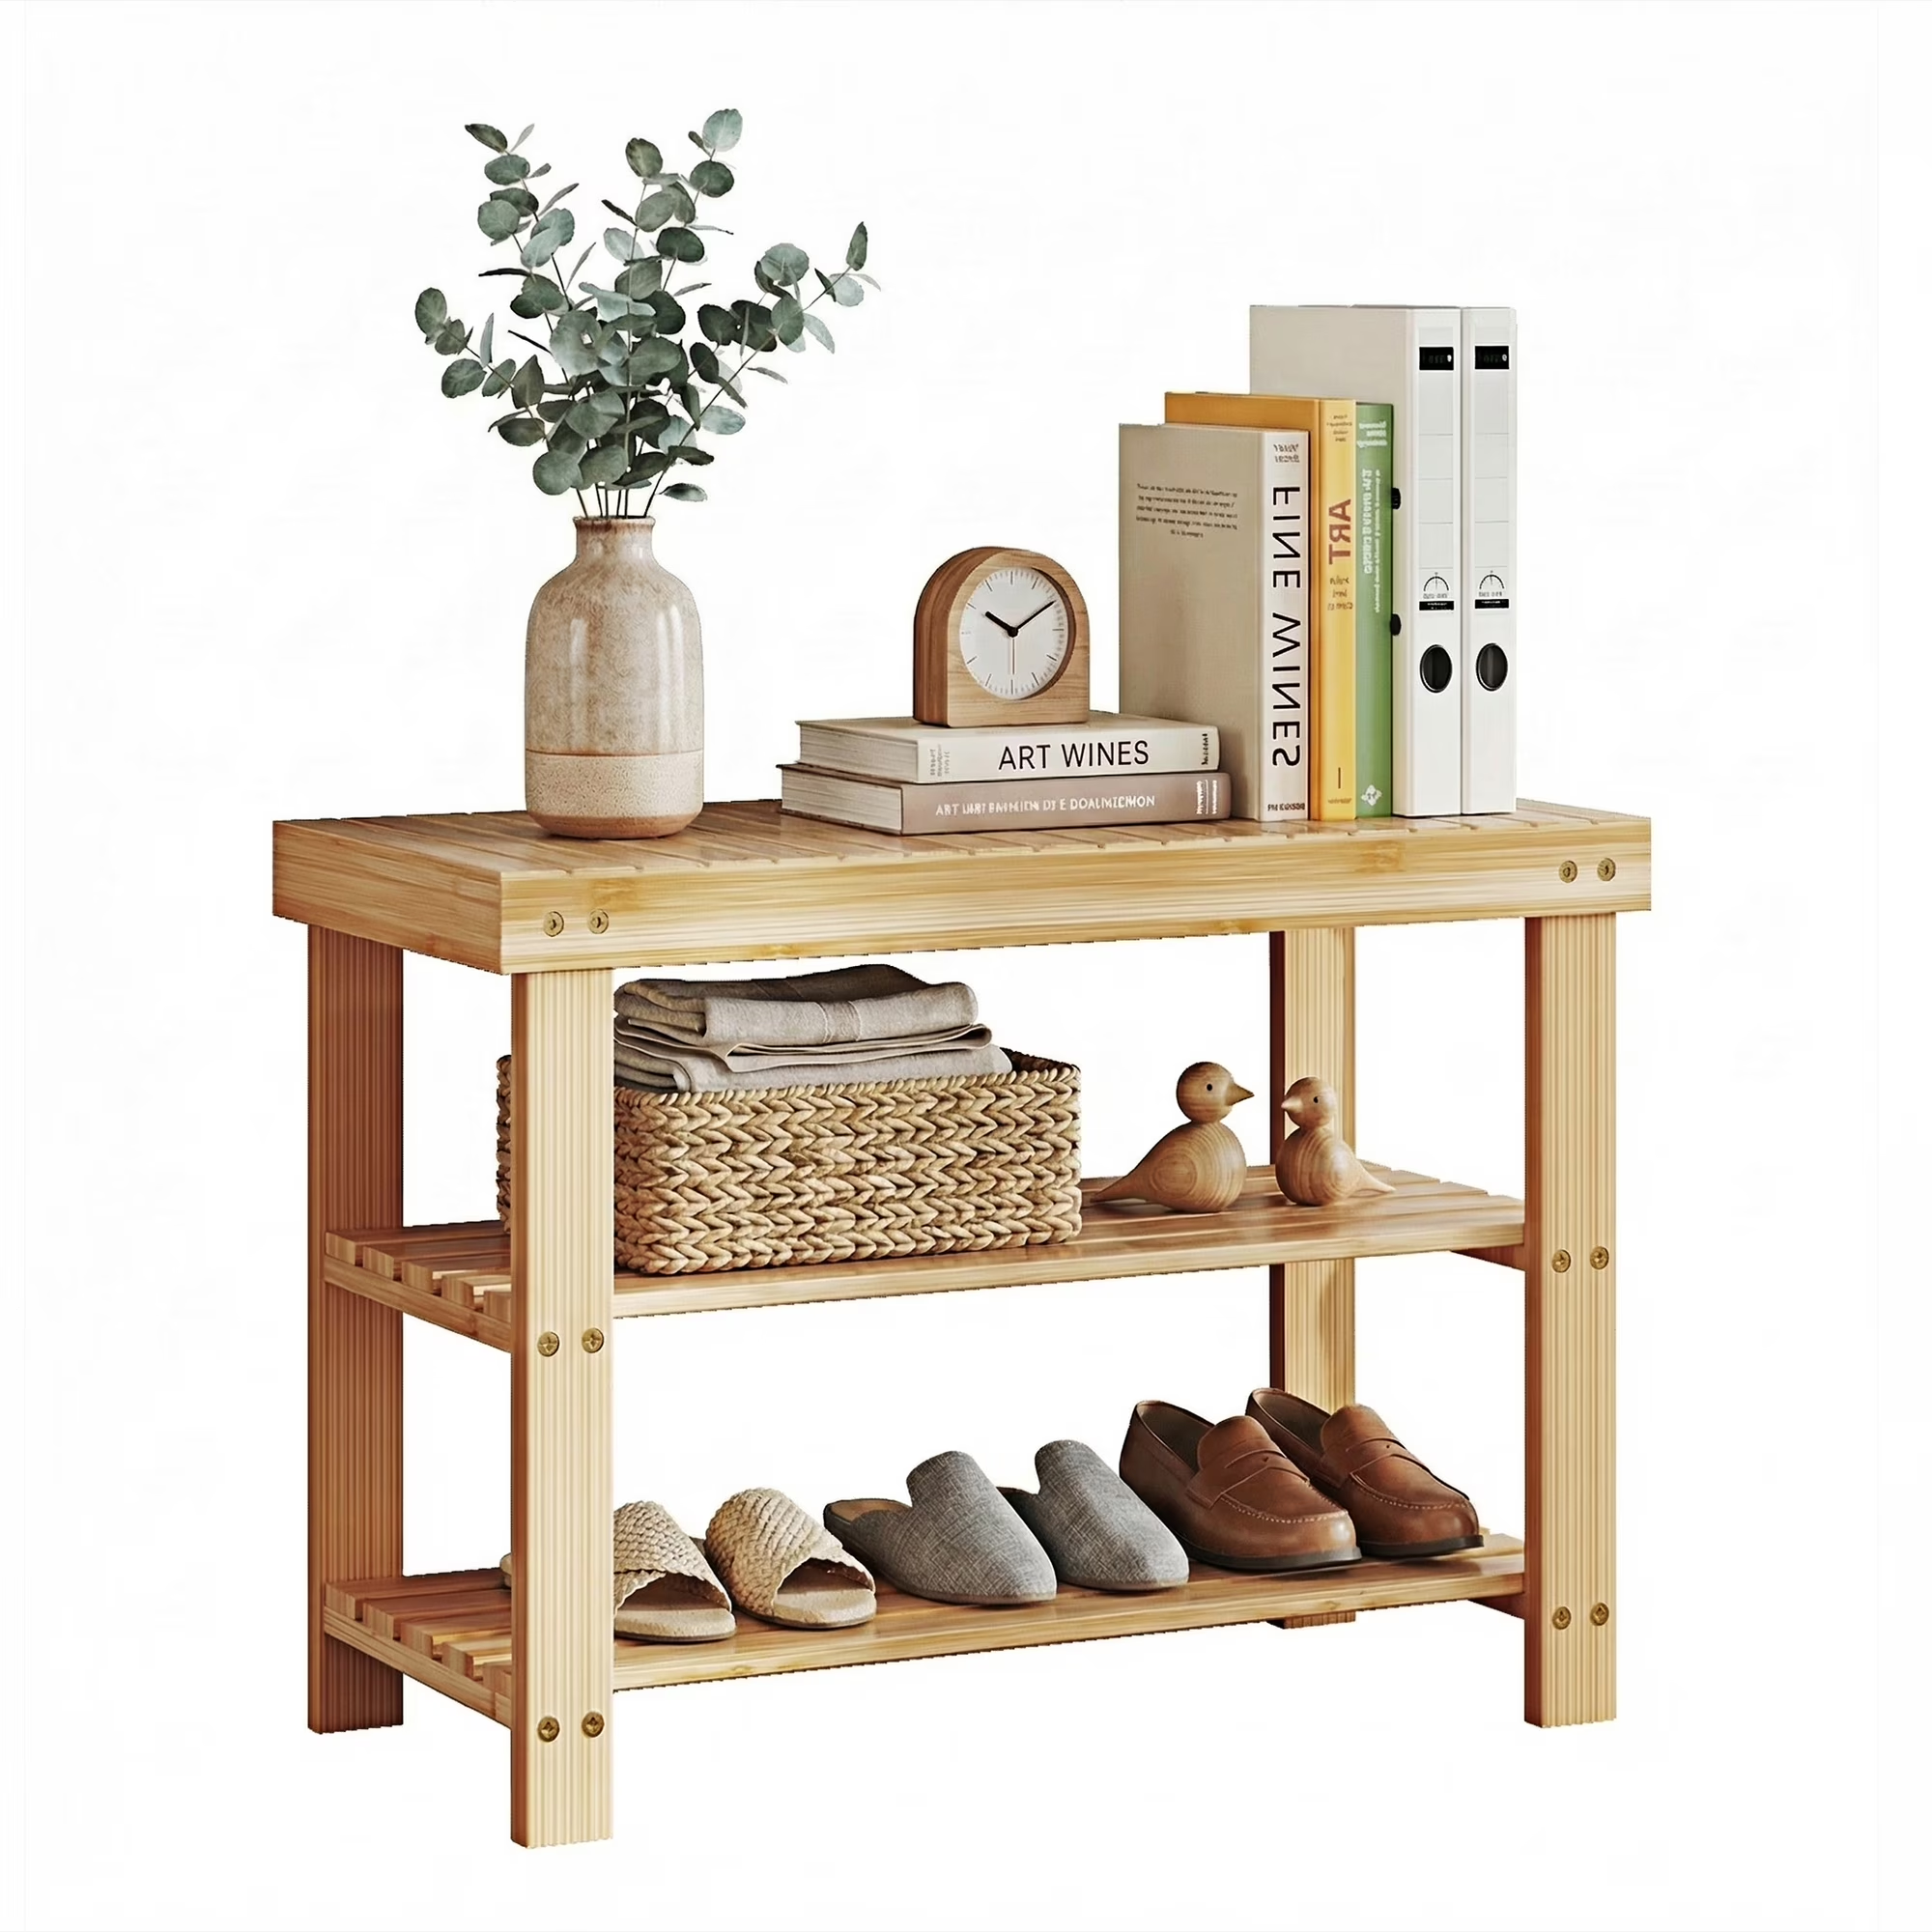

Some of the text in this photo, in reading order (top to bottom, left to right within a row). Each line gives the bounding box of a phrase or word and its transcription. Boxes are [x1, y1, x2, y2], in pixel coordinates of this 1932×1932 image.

[998, 740, 1150, 771] ART WINES
[935, 803, 959, 816] ART
